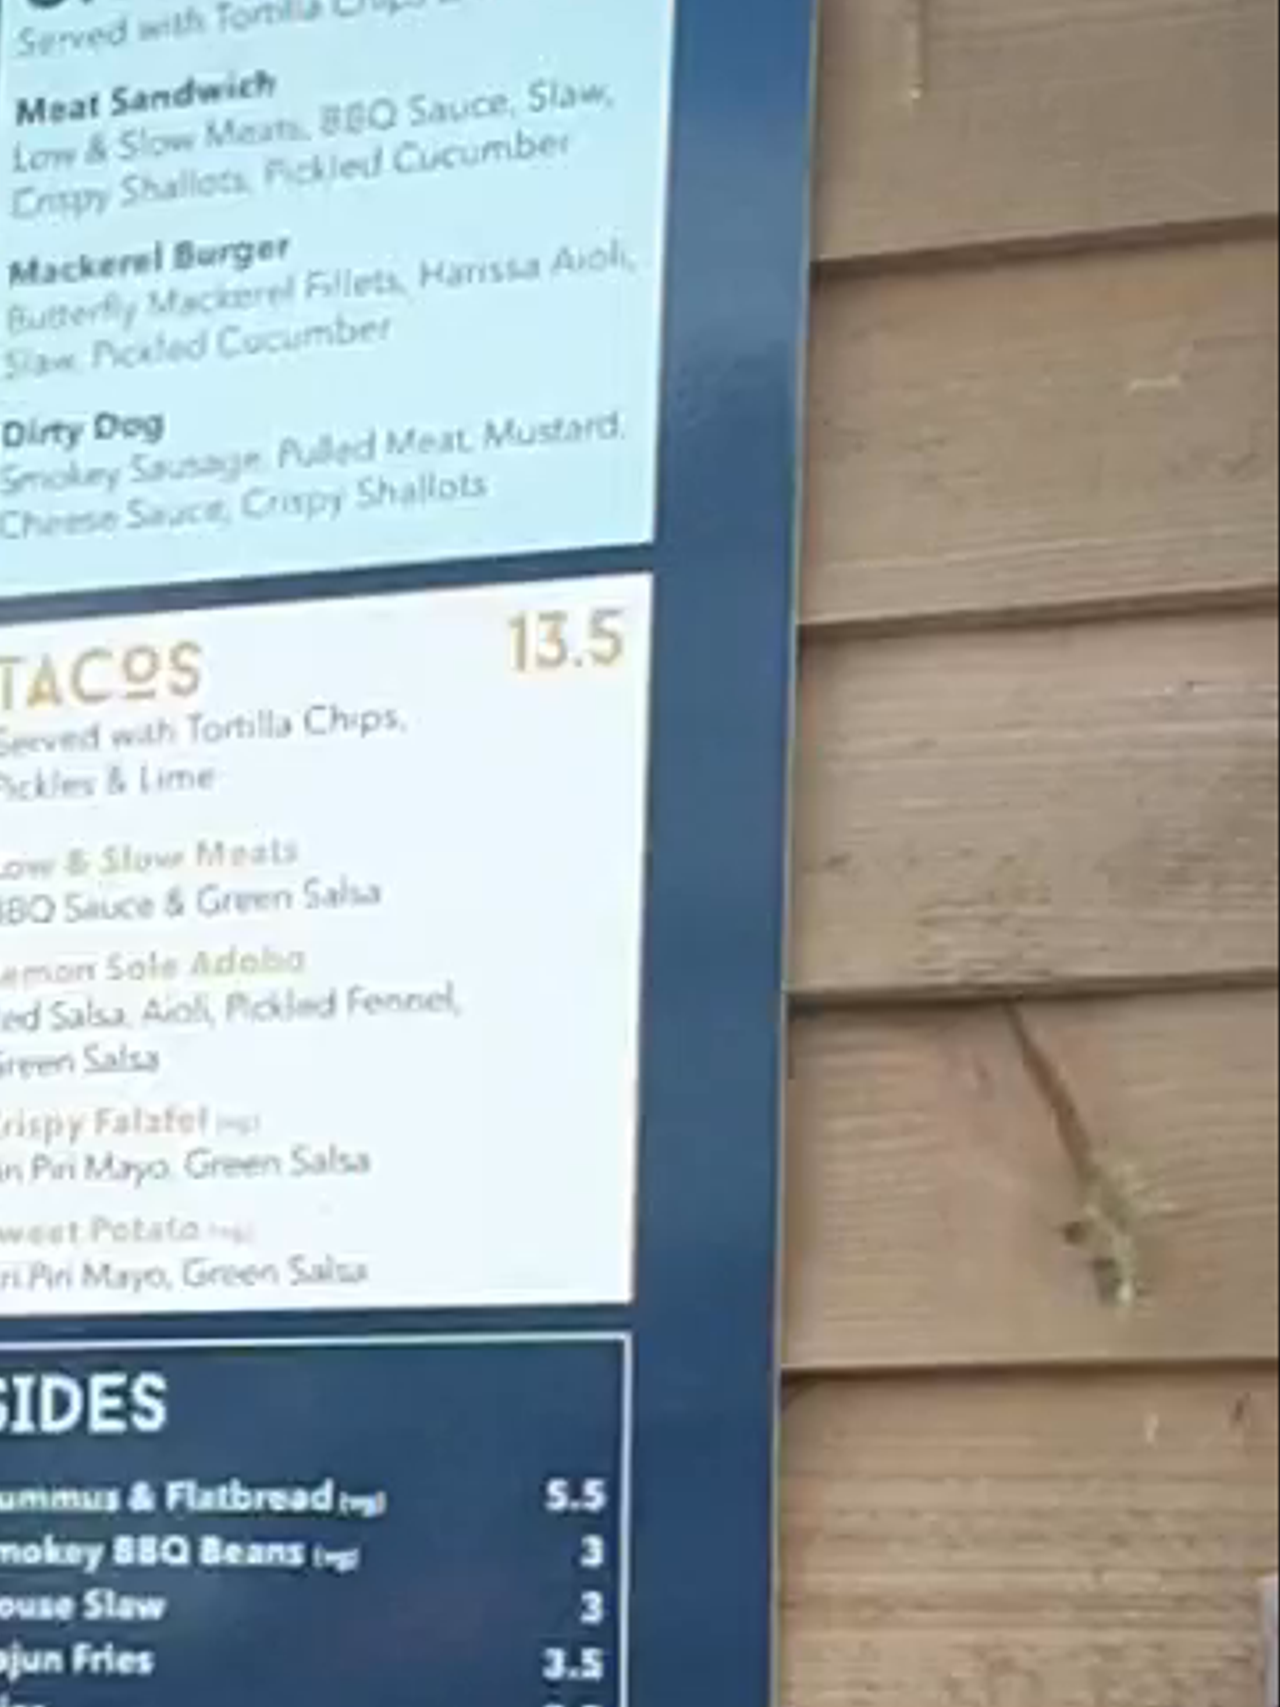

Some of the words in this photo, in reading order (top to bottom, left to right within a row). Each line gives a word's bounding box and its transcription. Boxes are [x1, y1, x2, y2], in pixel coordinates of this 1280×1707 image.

[17, 6, 128, 57] Served
[139, 3, 207, 41] with
[16, 94, 99, 125] Meat
[112, 70, 276, 116] Sandwich
[14, 137, 76, 174] Low
[117, 124, 195, 163] Slow
[392, 132, 571, 177] Cucumber
[8, 241, 163, 288] Mackerel
[173, 236, 290, 278] Burger
[217, 315, 392, 358] Cucumber
[1, 418, 85, 450] Dirty
[94, 410, 164, 444] Dog
[242, 483, 343, 525] Crispy
[356, 469, 488, 509] Shallots
[509, 609, 626, 671] 13.5
[111, 716, 177, 747] with
[187, 713, 293, 744] Tortilla
[107, 767, 127, 794] &
[138, 763, 215, 794] Lime
[196, 839, 300, 869] Meats
[64, 892, 154, 923] Sauce
[196, 882, 293, 916] Green
[303, 877, 382, 908] Salsa
[226, 994, 337, 1023] Pickled
[83, 1043, 160, 1075] Salsa
[184, 1146, 281, 1179] Green
[290, 1143, 371, 1175] Salsa
[90, 1215, 198, 1243] Potato
[182, 1256, 278, 1289] Green
[289, 1253, 369, 1285] Salsa
[129, 1481, 153, 1511] &
[165, 1478, 333, 1513] Flatbread
[545, 1478, 606, 1511] 5.5
[113, 1536, 190, 1566] BBQ
[200, 1536, 304, 1566] Beans
[581, 1537, 603, 1567] 3
[84, 1591, 166, 1619] Slaw
[581, 1593, 603, 1624] 3
[71, 1642, 154, 1675] Fries
[543, 1647, 605, 1679] 3.5
